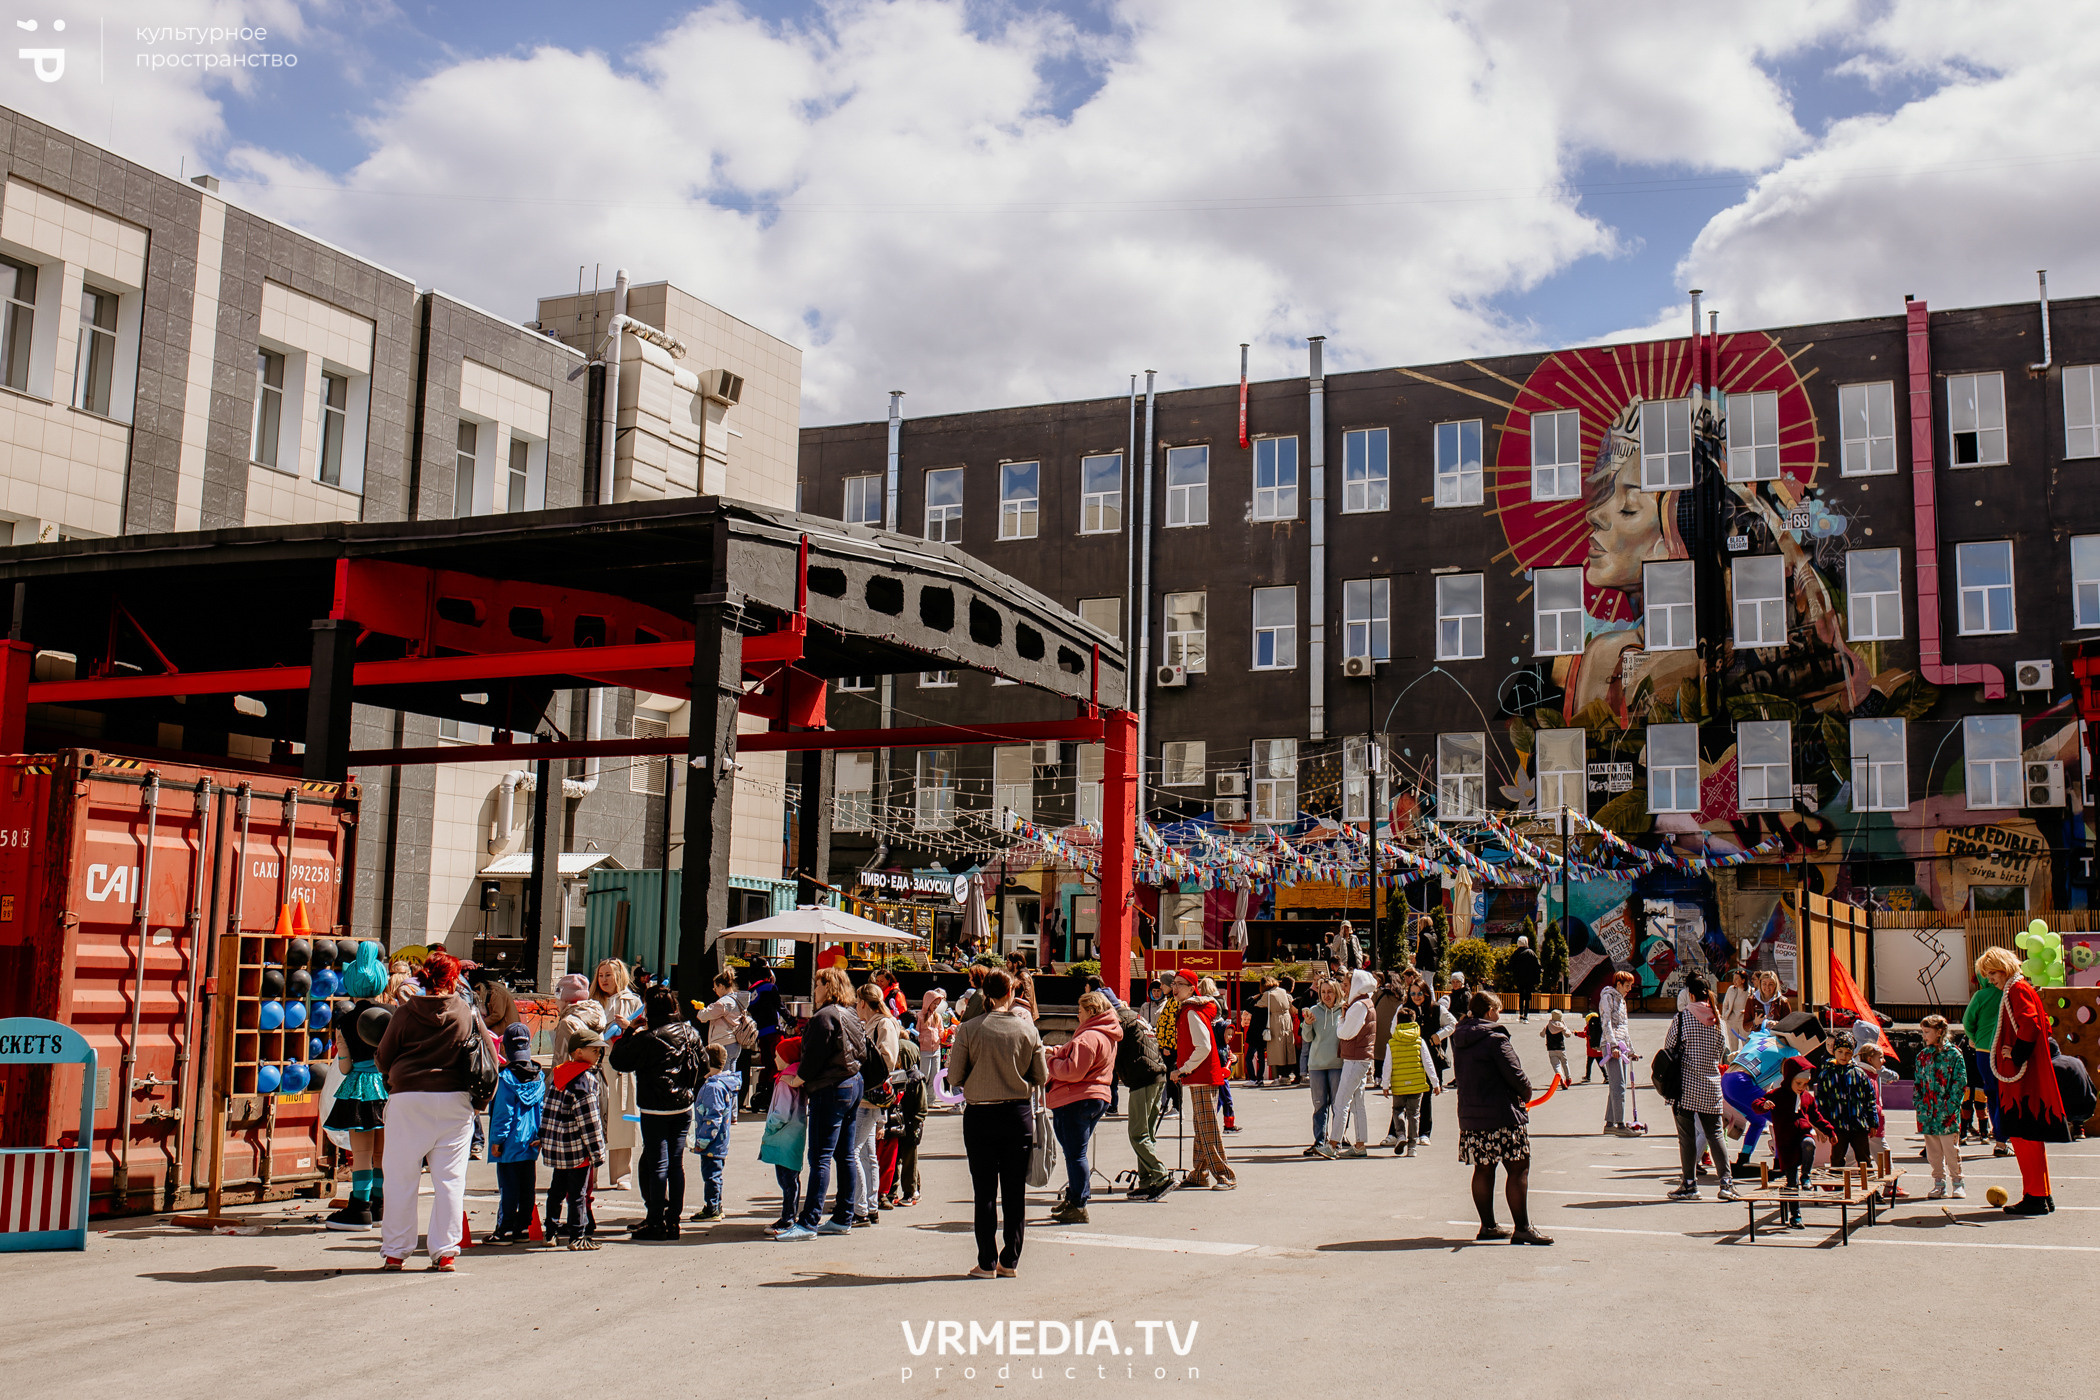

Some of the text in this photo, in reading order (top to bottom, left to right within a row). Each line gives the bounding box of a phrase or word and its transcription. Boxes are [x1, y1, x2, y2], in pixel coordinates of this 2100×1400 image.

[1729, 542, 1748, 550] TUESDAY
[1589, 763, 1632, 773] MAN ON THE
[1610, 772, 1632, 781] MOON
[1946, 826, 2040, 855] INCREDIBLE
[253, 861, 279, 879] CAXU
[291, 864, 330, 883] 992258
[2000, 870, 2027, 884] birth
[86, 863, 140, 904] CAI
[860, 872, 952, 895] ПИВО ЕДА ЗАКУСКИ
[291, 887, 316, 904] 45G1
[1600, 921, 1624, 941] WHO IS
[1605, 934, 1621, 947] JACK
[0, 1034, 62, 1055] CKETS
